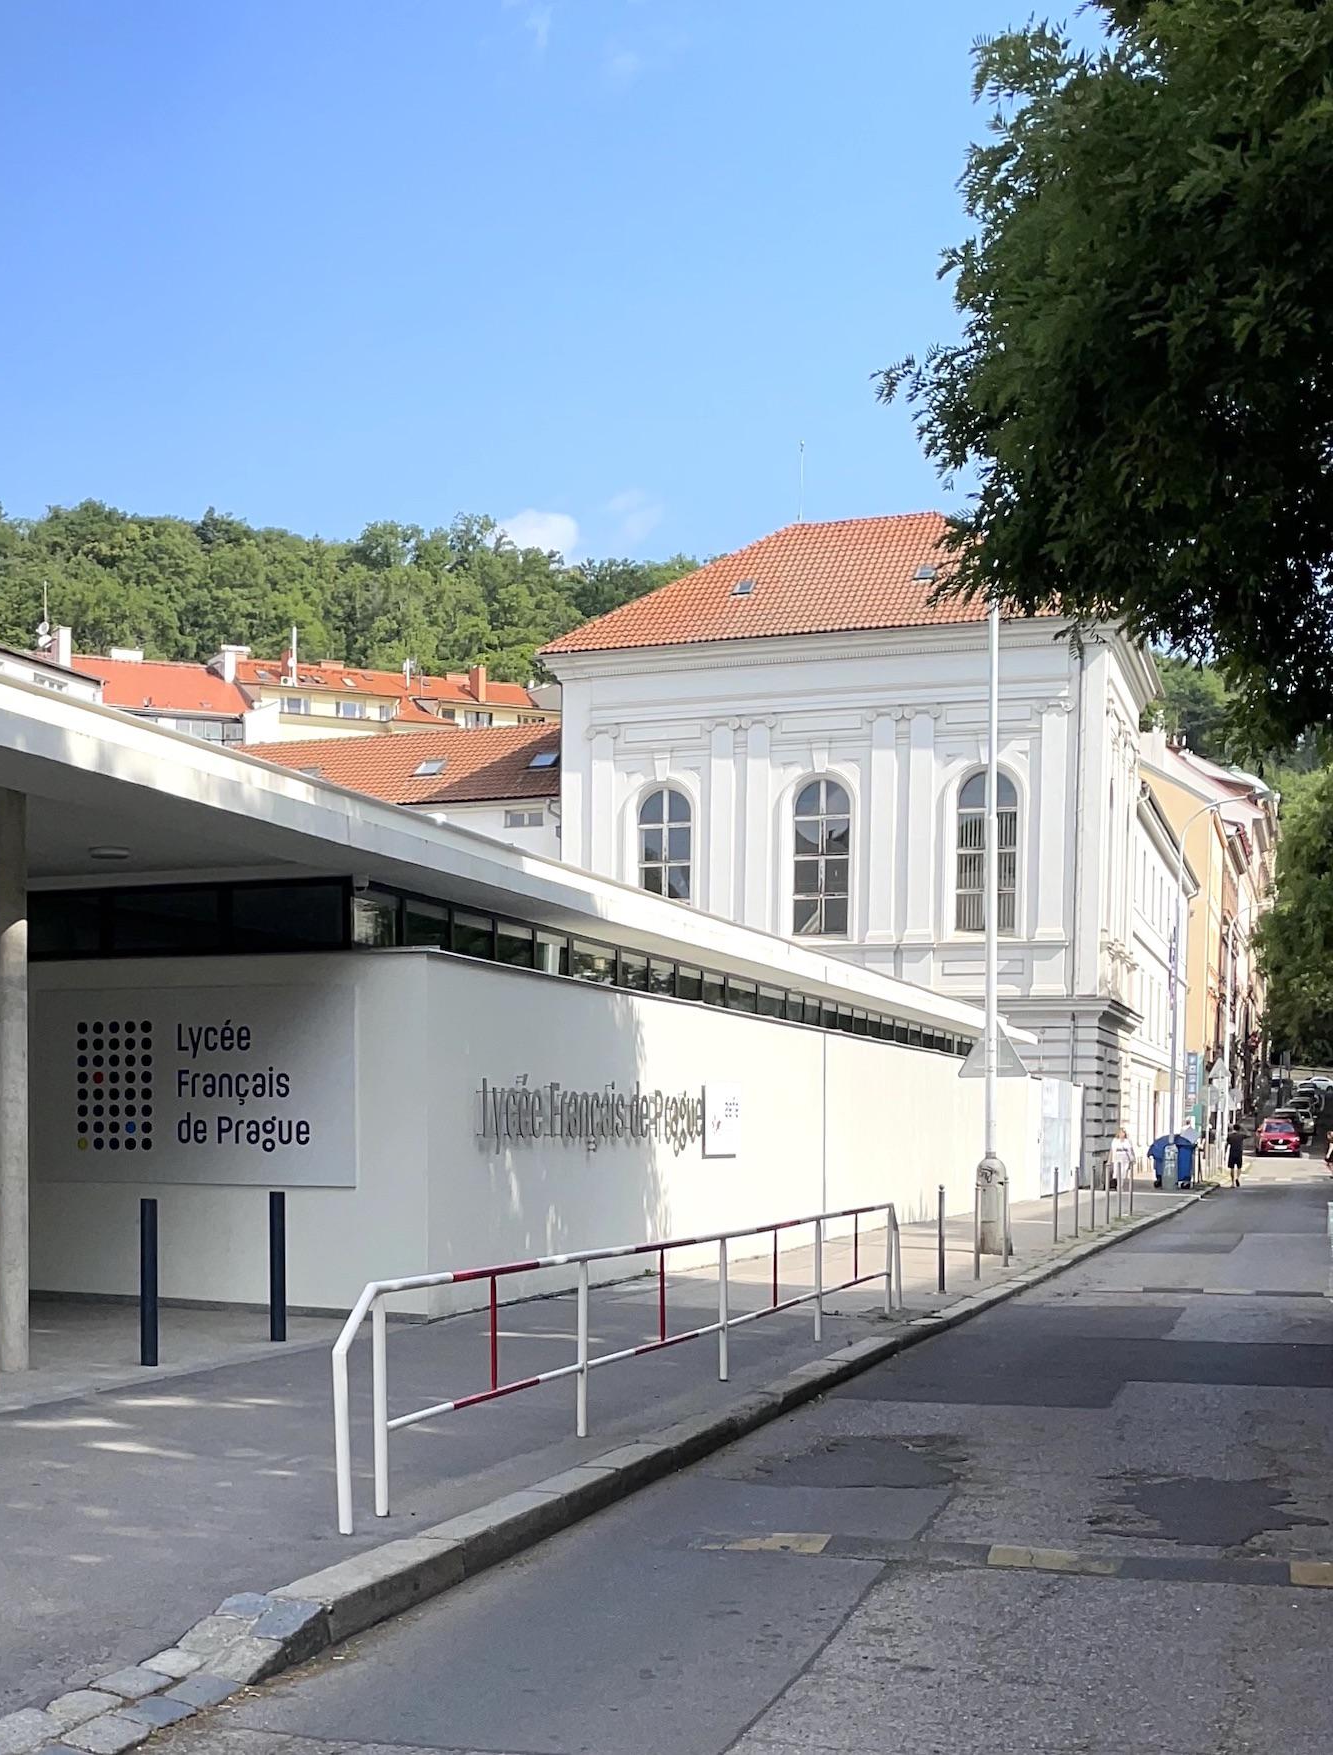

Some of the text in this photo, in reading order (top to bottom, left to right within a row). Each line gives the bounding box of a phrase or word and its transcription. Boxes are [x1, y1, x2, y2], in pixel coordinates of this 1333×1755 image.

[177, 1019, 251, 1058] Lycée
[177, 1066, 290, 1105] Français
[177, 1112, 310, 1152] de Prague
[481, 1073, 543, 1155] Lycée
[550, 1080, 625, 1152] Français
[630, 1080, 649, 1138] de
